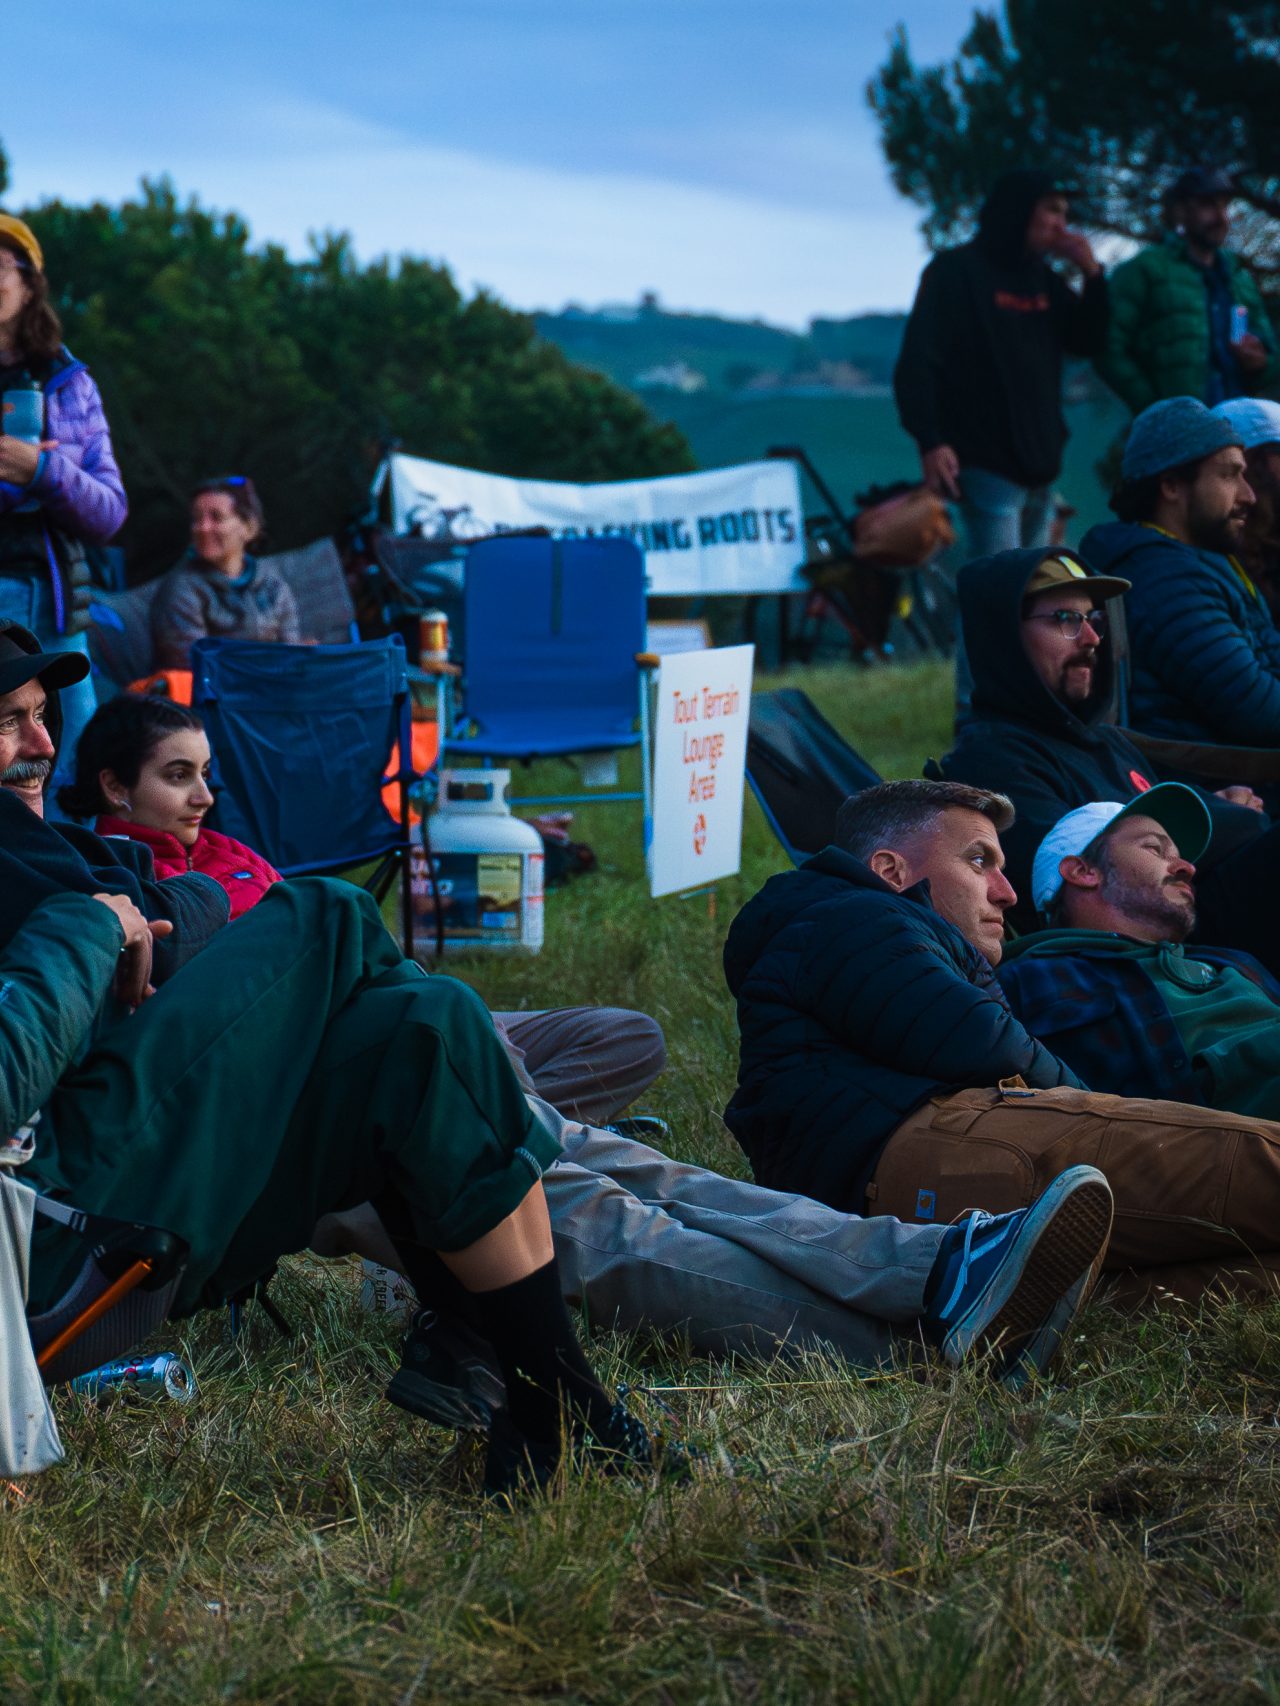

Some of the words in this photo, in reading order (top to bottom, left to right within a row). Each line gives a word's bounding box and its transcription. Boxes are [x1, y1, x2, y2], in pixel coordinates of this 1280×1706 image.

[698, 507, 795, 546] ROOTS
[672, 690, 697, 724] Tout
[702, 685, 739, 720] Terrain
[683, 731, 724, 770] Lounge
[688, 769, 716, 803] Area
